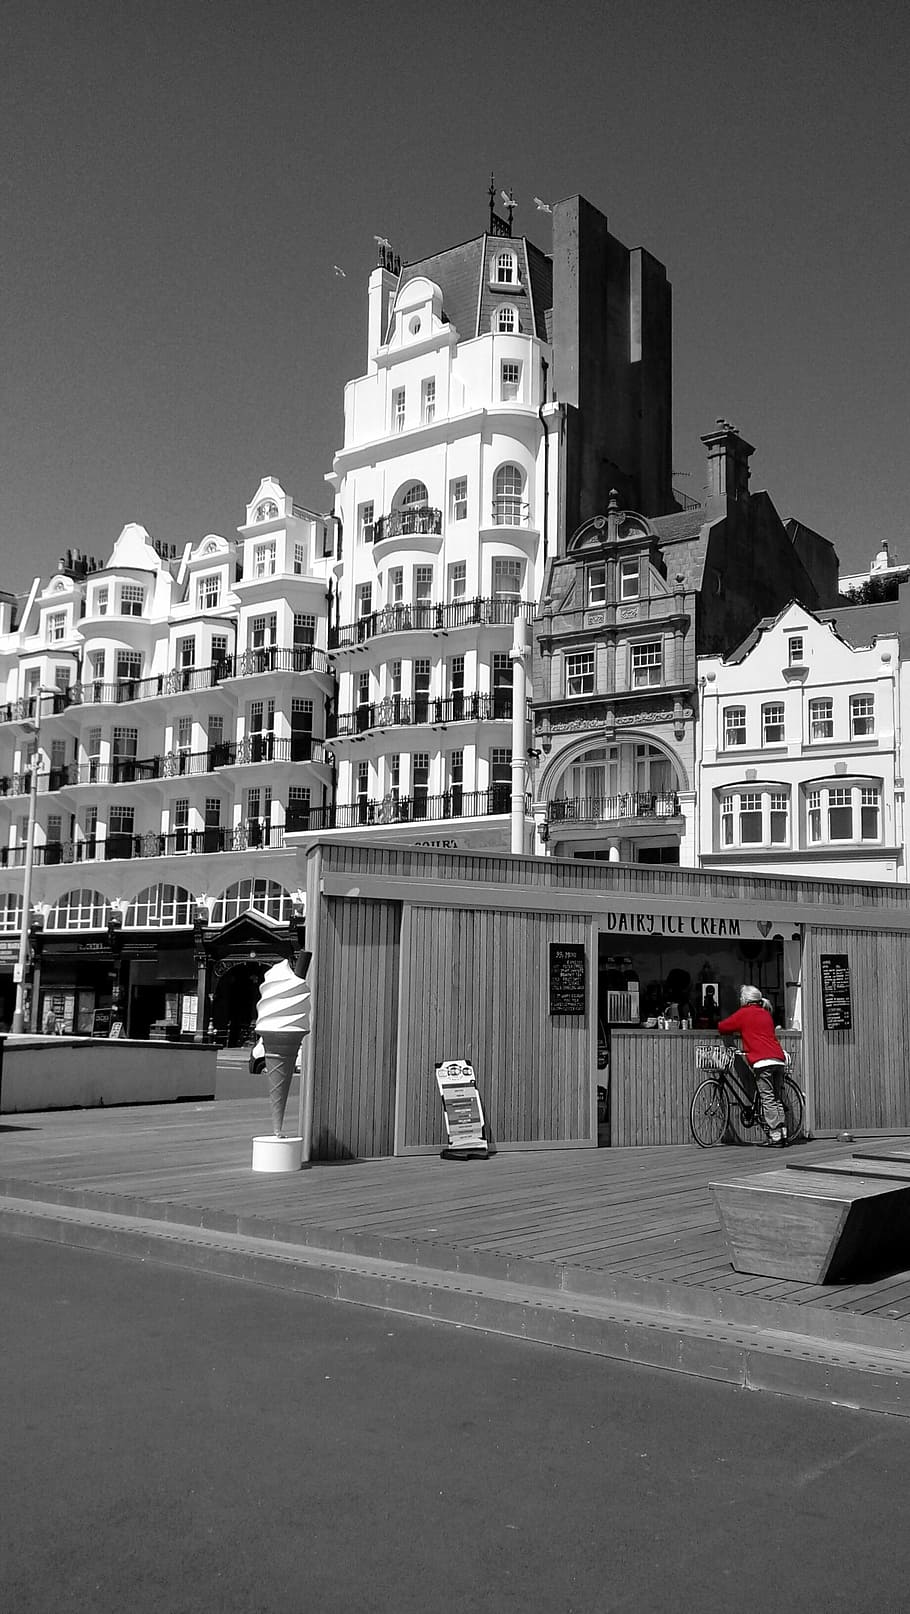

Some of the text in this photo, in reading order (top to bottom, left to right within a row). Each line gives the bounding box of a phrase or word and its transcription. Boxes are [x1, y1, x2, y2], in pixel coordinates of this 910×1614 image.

[607, 912, 741, 936] DAIRY ICE CREAM
